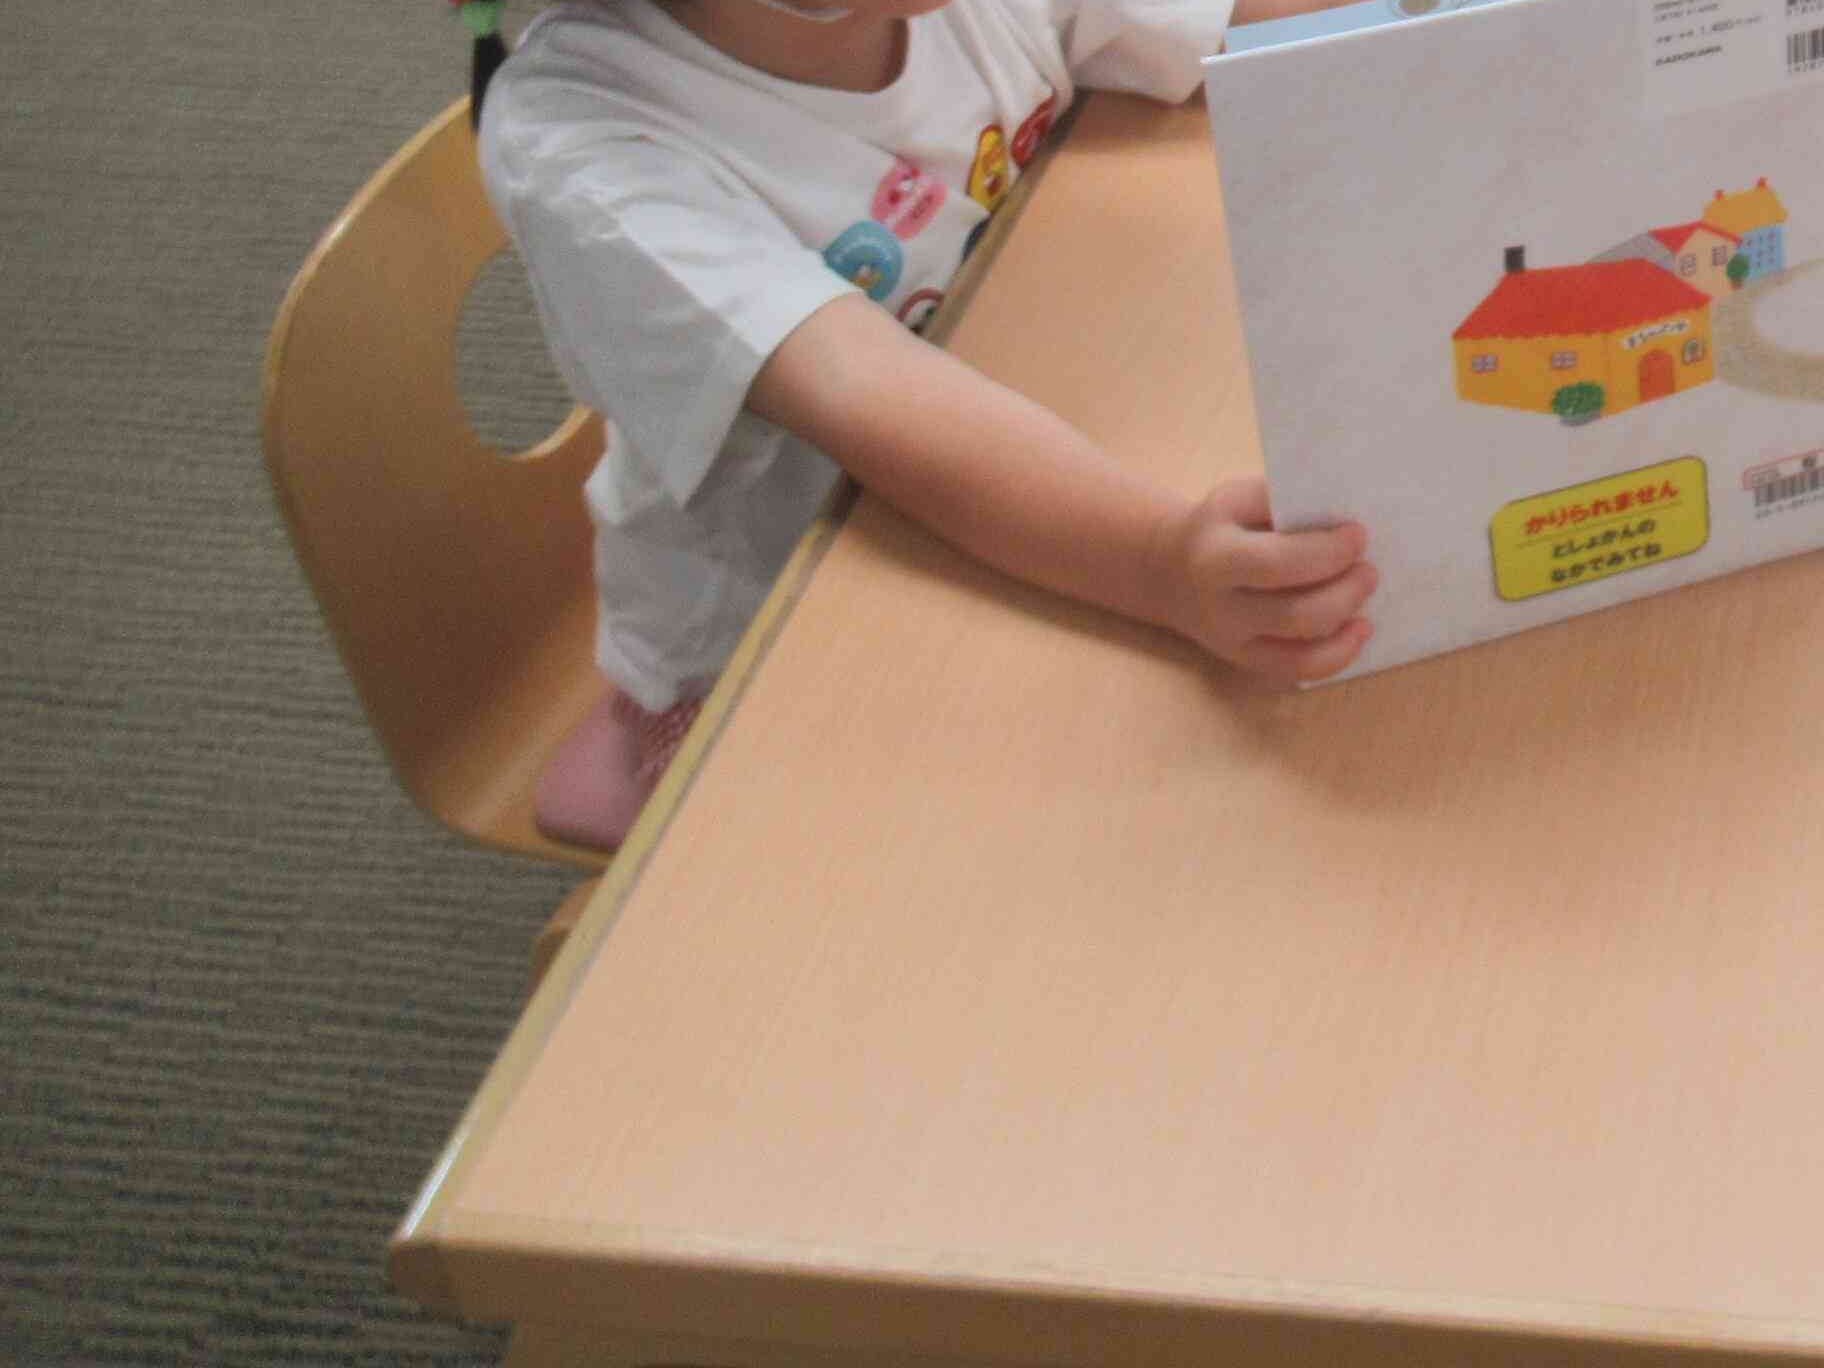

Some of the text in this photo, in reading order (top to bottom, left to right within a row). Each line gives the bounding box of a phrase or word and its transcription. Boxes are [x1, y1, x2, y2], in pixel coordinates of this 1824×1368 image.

[1524, 480, 1680, 536] かりられません
[1552, 518, 1657, 559] としょかんの
[1552, 542, 1662, 583] なかでみてね
